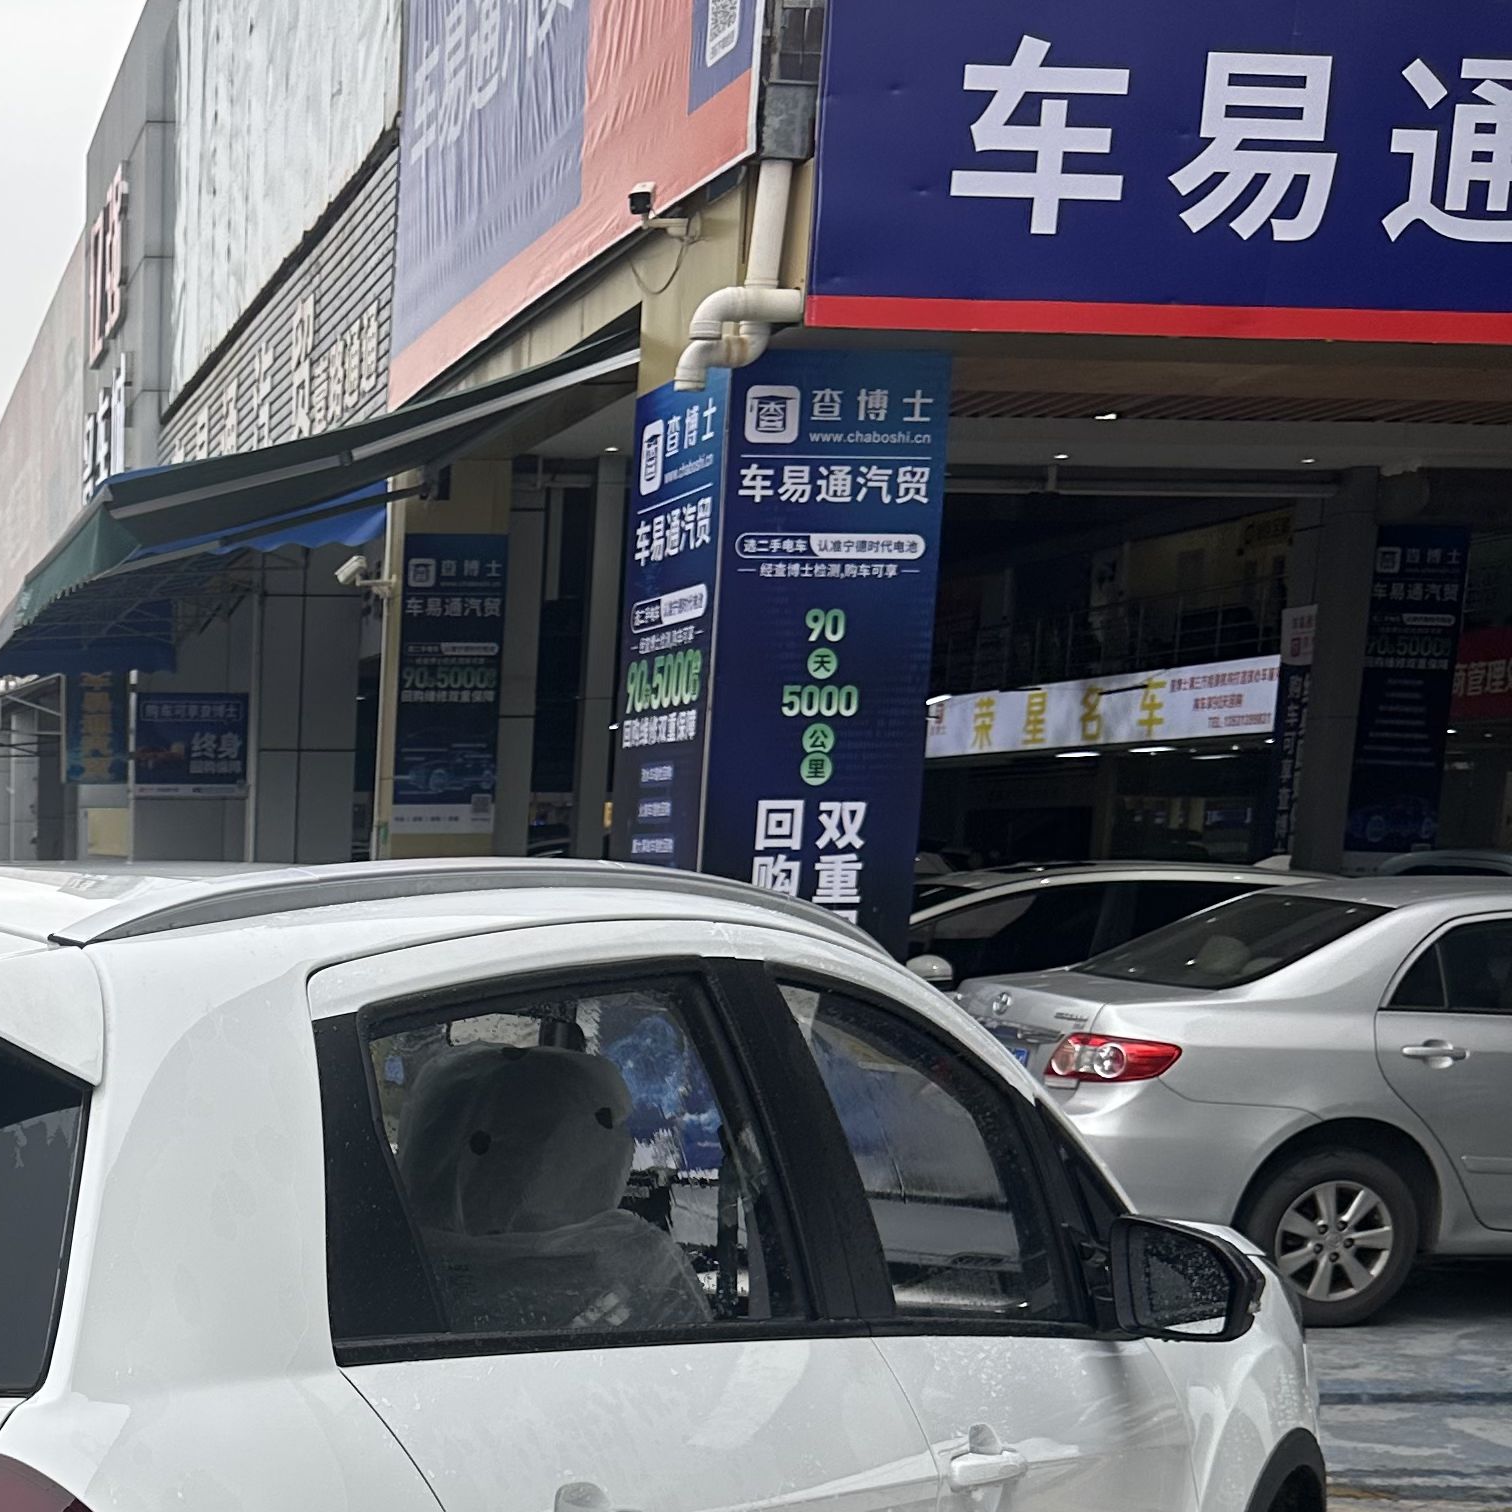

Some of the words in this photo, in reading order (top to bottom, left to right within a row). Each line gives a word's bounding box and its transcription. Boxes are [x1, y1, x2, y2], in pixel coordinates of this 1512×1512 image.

[950, 34, 1512, 243] 车易通
[810, 388, 935, 422] 查博士
[665, 397, 718, 458] 查博士
[809, 431, 932, 444] www.chaboshi.cn
[737, 463, 930, 504] 车易通汽贸
[634, 496, 713, 567] 车易通汽贸
[817, 539, 919, 554] 认准宁德时代电池
[404, 597, 502, 617] 车易通汽贸
[805, 607, 847, 642] 90
[811, 653, 832, 673] 天
[781, 684, 859, 717] 5000
[971, 677, 1167, 751] 荣星名车
[190, 731, 243, 759] 终身
[806, 730, 829, 779] 公里
[811, 801, 867, 925] 双重
